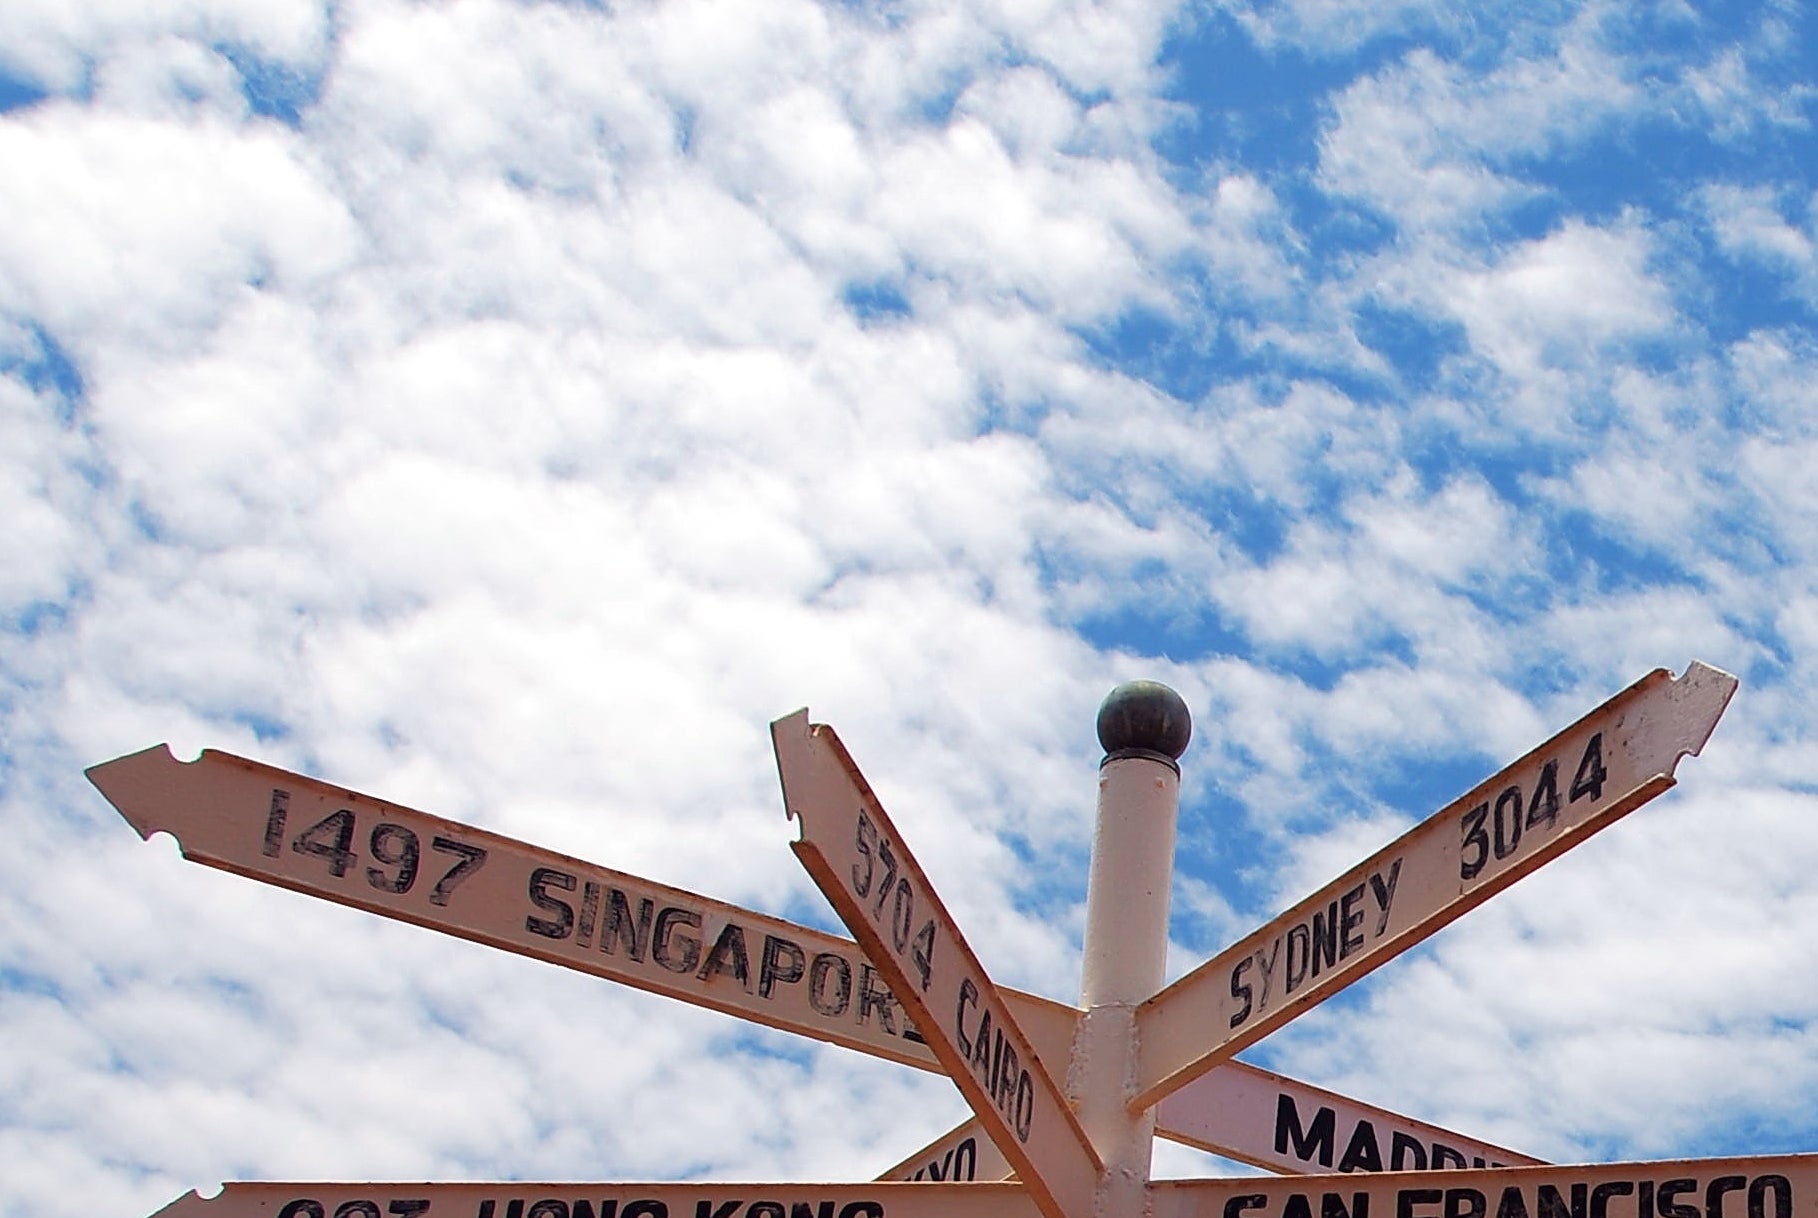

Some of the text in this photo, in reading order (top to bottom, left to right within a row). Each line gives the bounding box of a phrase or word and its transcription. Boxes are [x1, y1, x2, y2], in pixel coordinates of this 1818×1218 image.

[263, 788, 928, 1045] 1497 SINGAPOR
[852, 808, 1034, 1144] 5704 CAIRO
[1229, 733, 1608, 1029] SYDNEY 3044
